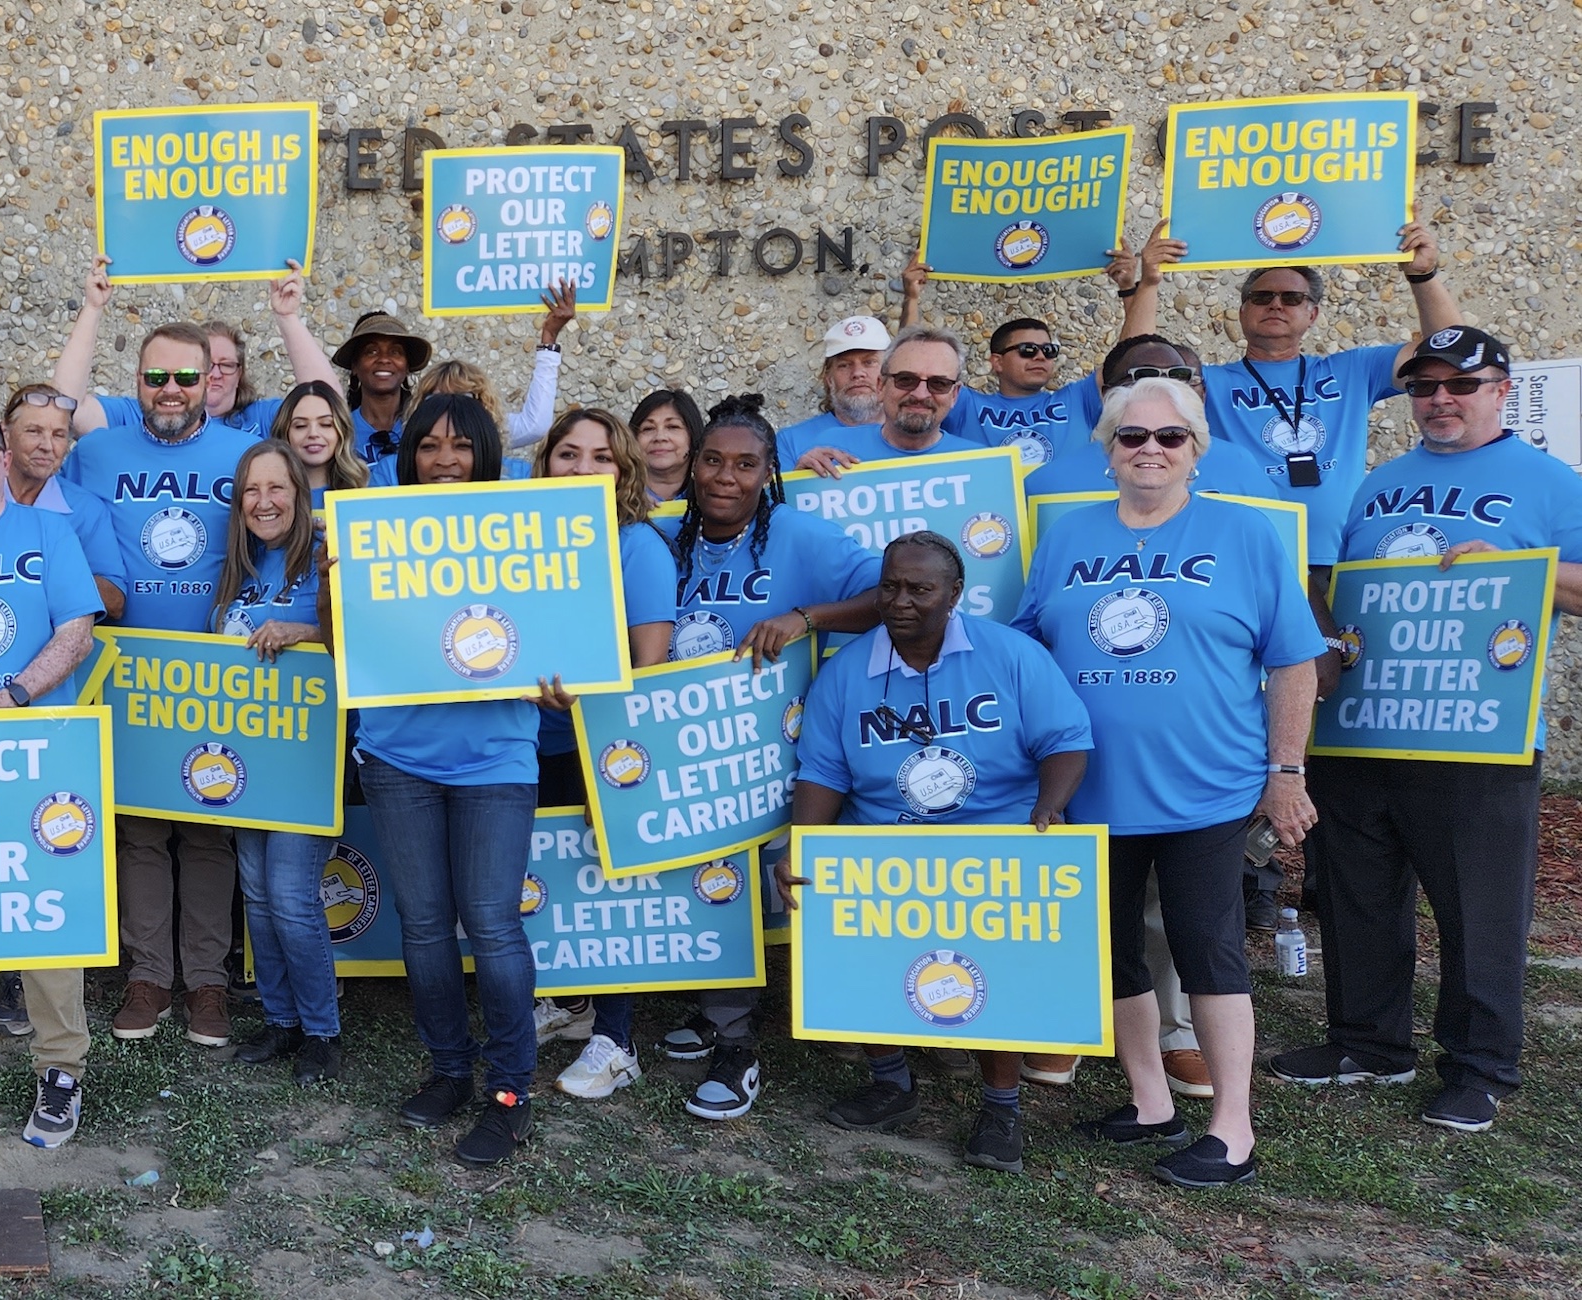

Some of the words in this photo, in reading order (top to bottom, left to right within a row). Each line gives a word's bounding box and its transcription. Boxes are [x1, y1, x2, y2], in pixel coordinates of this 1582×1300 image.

[111, 130, 261, 168] ENOUGH
[272, 134, 301, 161] IS
[1185, 118, 1356, 158] ENOUGH
[1367, 122, 1398, 148] IS
[125, 163, 288, 201] ENOUGH!
[466, 166, 597, 195] PROTECT
[941, 154, 1082, 187] ENOUGH
[1090, 155, 1116, 179] IS
[1198, 150, 1383, 189] ENOUGH!
[500, 198, 566, 226] OUR
[951, 180, 1102, 215] ENOUGH!
[479, 230, 583, 260] LETTER
[456, 262, 597, 292] CARRIERS
[978, 402, 1070, 430] NALC
[1526, 375, 1548, 424] Security
[796, 474, 971, 520] PROTECT
[1363, 484, 1515, 527] NALC
[349, 511, 543, 560] ENOUGH
[556, 515, 595, 548] IS
[134, 580, 165, 595] EST
[170, 581, 213, 595] 1889
[369, 551, 580, 600] ENOUGH!
[1062, 553, 1217, 591] NALC
[1360, 576, 1510, 614] PROTECT
[1389, 620, 1465, 653] OUR
[113, 655, 279, 702] ENOUGH
[292, 676, 327, 705] IS
[624, 661, 788, 727] PROTECT
[1078, 670, 1115, 685] EST
[1122, 669, 1178, 686] 1889
[1362, 658, 1482, 692] LETTER
[127, 692, 309, 742] ENOUGH!
[677, 711, 760, 757] OUR
[859, 692, 1003, 748] NALC
[1337, 698, 1500, 733] CARRIERS
[656, 742, 782, 801] LETTER
[347, 851, 360, 863] OF
[357, 861, 376, 892] LETTER
[814, 857, 1021, 897] ENOUGH
[1039, 864, 1082, 898] IS
[349, 894, 376, 934] CARRIERS
[552, 896, 692, 933] LETTER
[833, 899, 1061, 943] ENOUGH!
[533, 931, 722, 971] CARRIERS
[1295, 945, 1306, 974] hint
